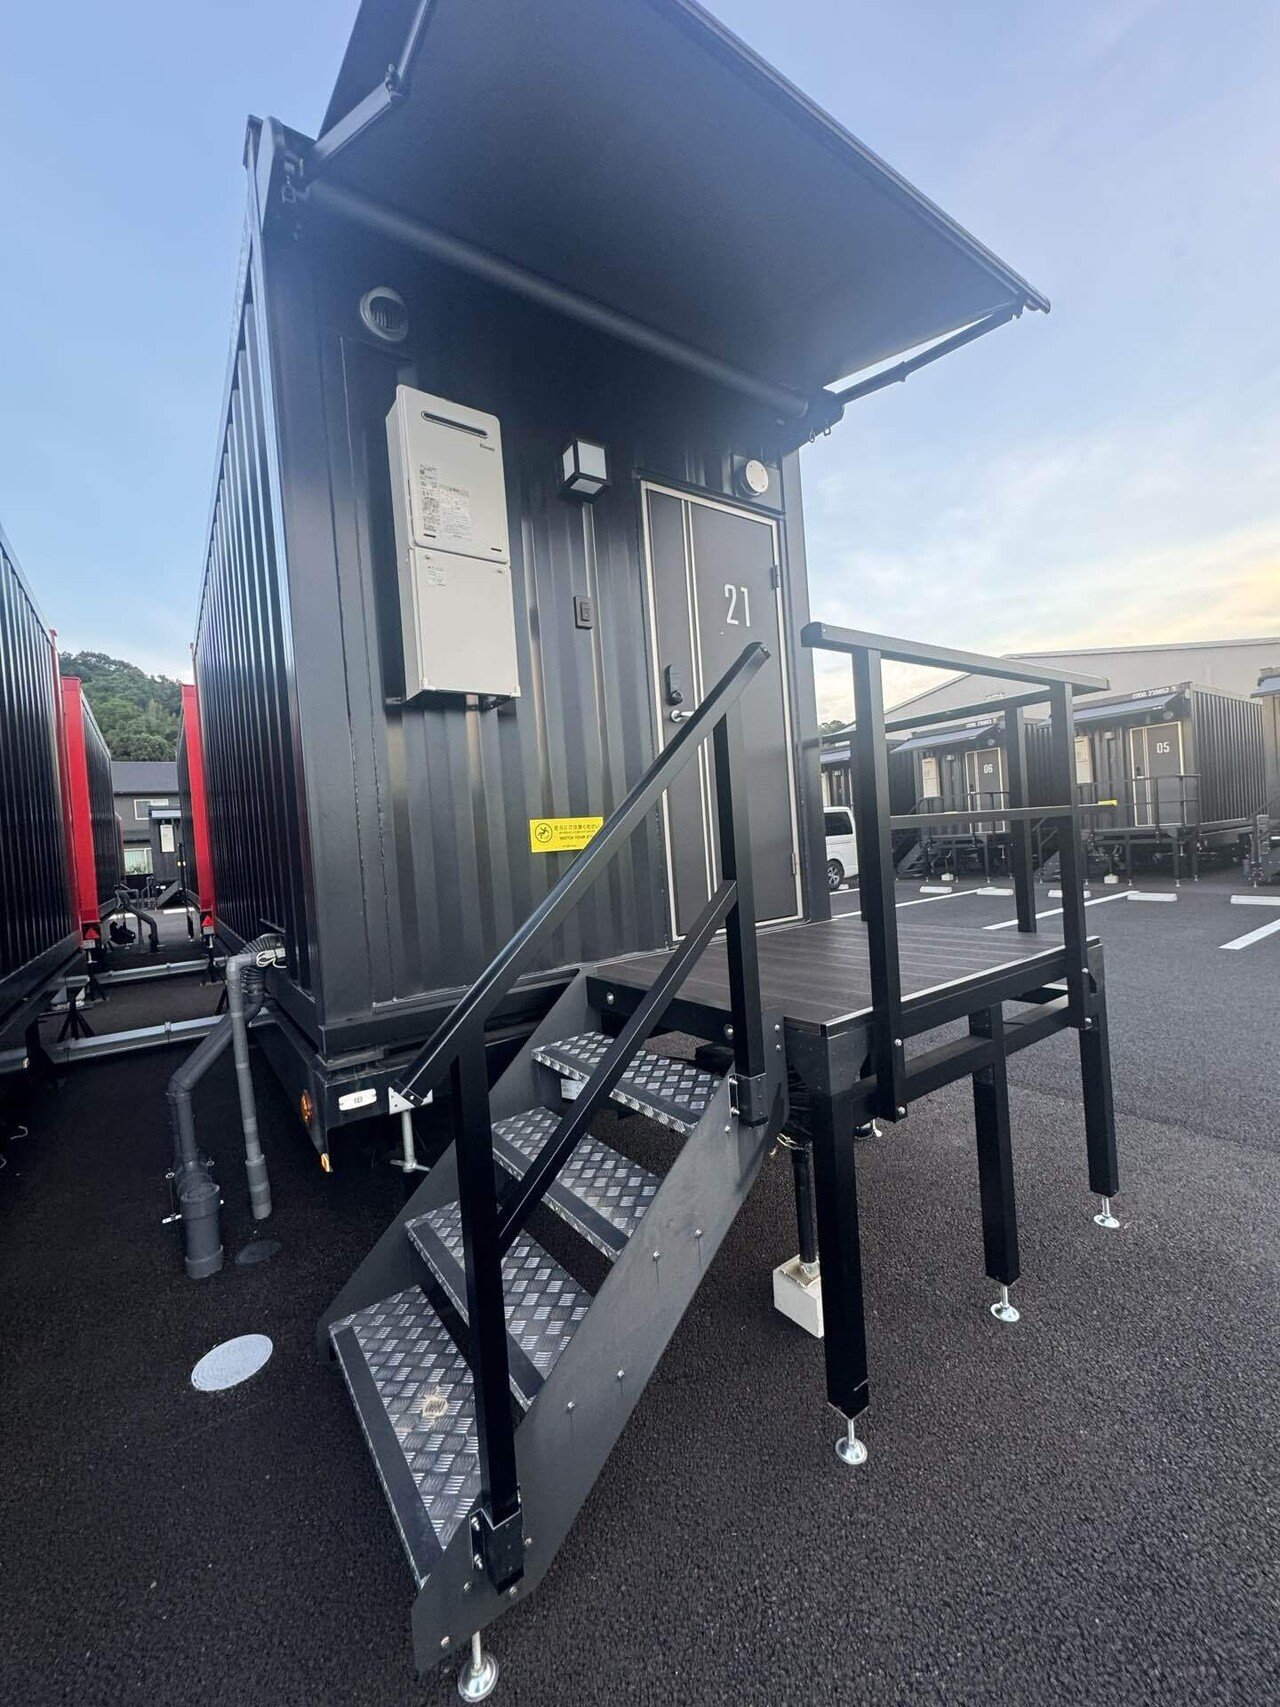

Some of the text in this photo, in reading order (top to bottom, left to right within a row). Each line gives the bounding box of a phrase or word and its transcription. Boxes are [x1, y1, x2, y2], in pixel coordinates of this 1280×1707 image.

[724, 584, 750, 627] 21
[1156, 741, 1170, 754] 05
[983, 763, 993, 774] 06
